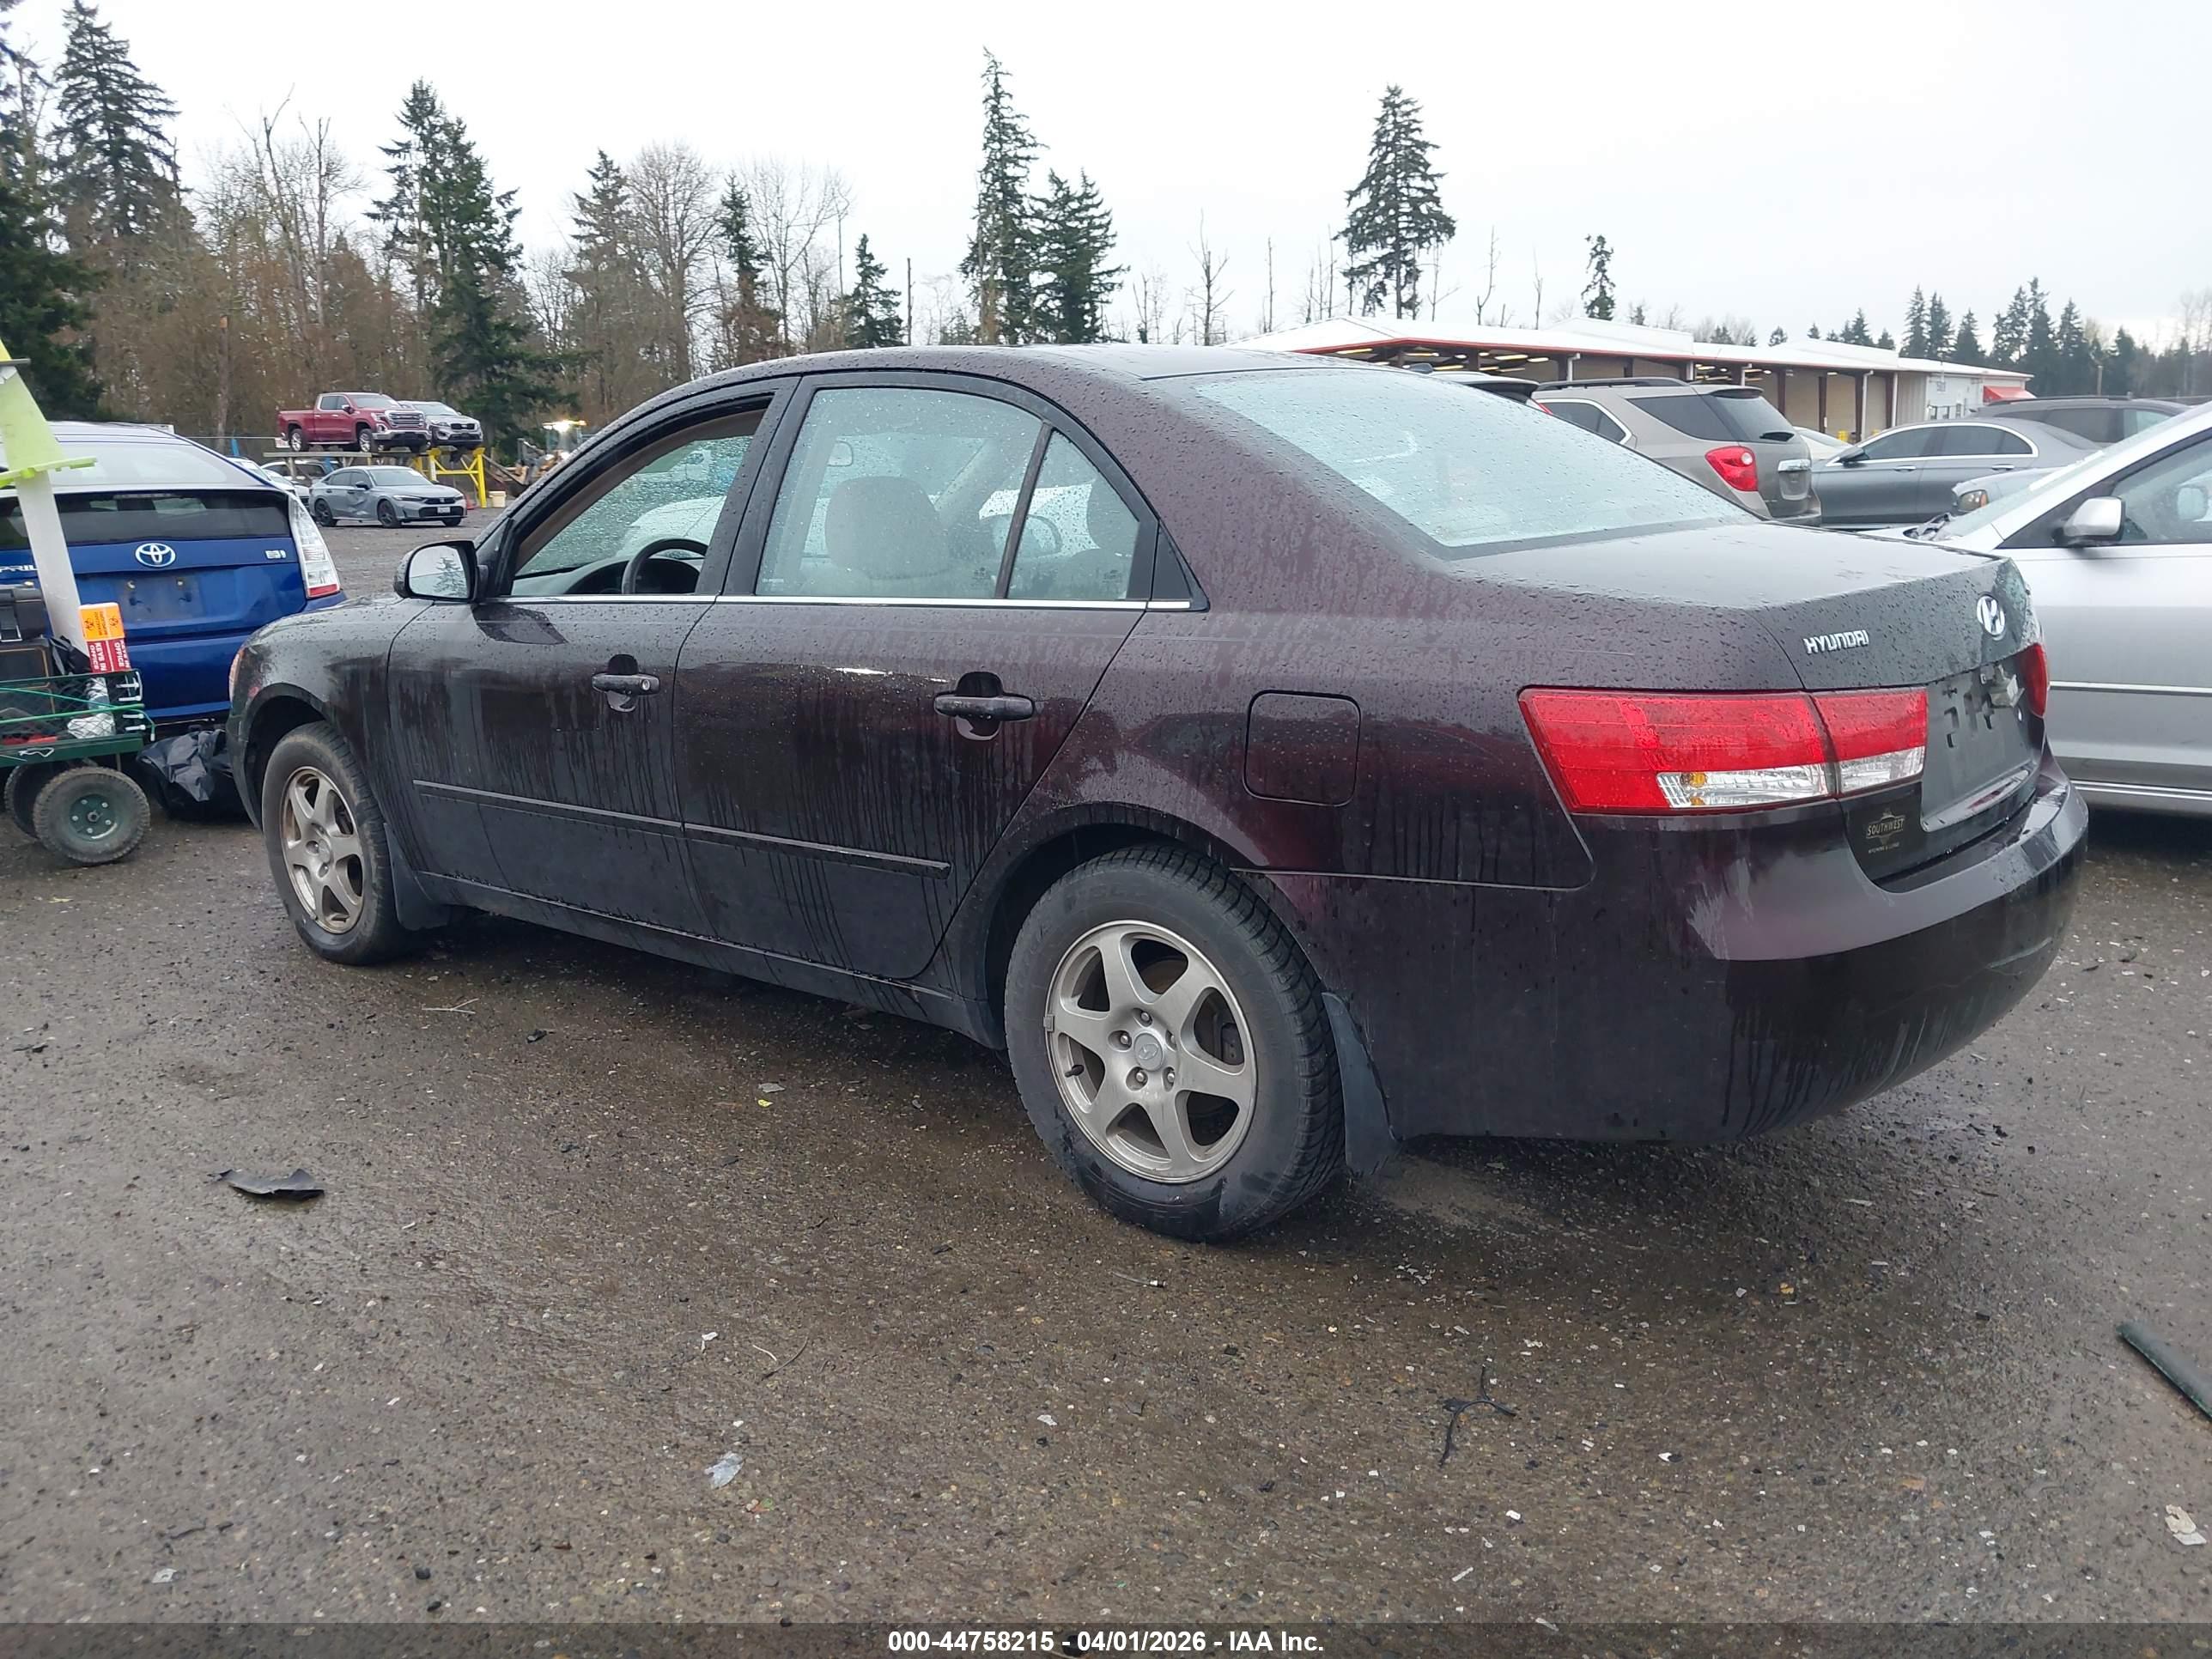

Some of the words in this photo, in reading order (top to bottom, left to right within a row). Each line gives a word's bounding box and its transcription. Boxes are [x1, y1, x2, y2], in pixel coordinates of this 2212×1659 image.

[95, 642, 106, 662] KEYS
[1802, 629, 1870, 654] HYUNDAI
[89, 644, 100, 670] OFFICE
[100, 662, 107, 672] IN
[114, 641, 125, 668] OFFICE
